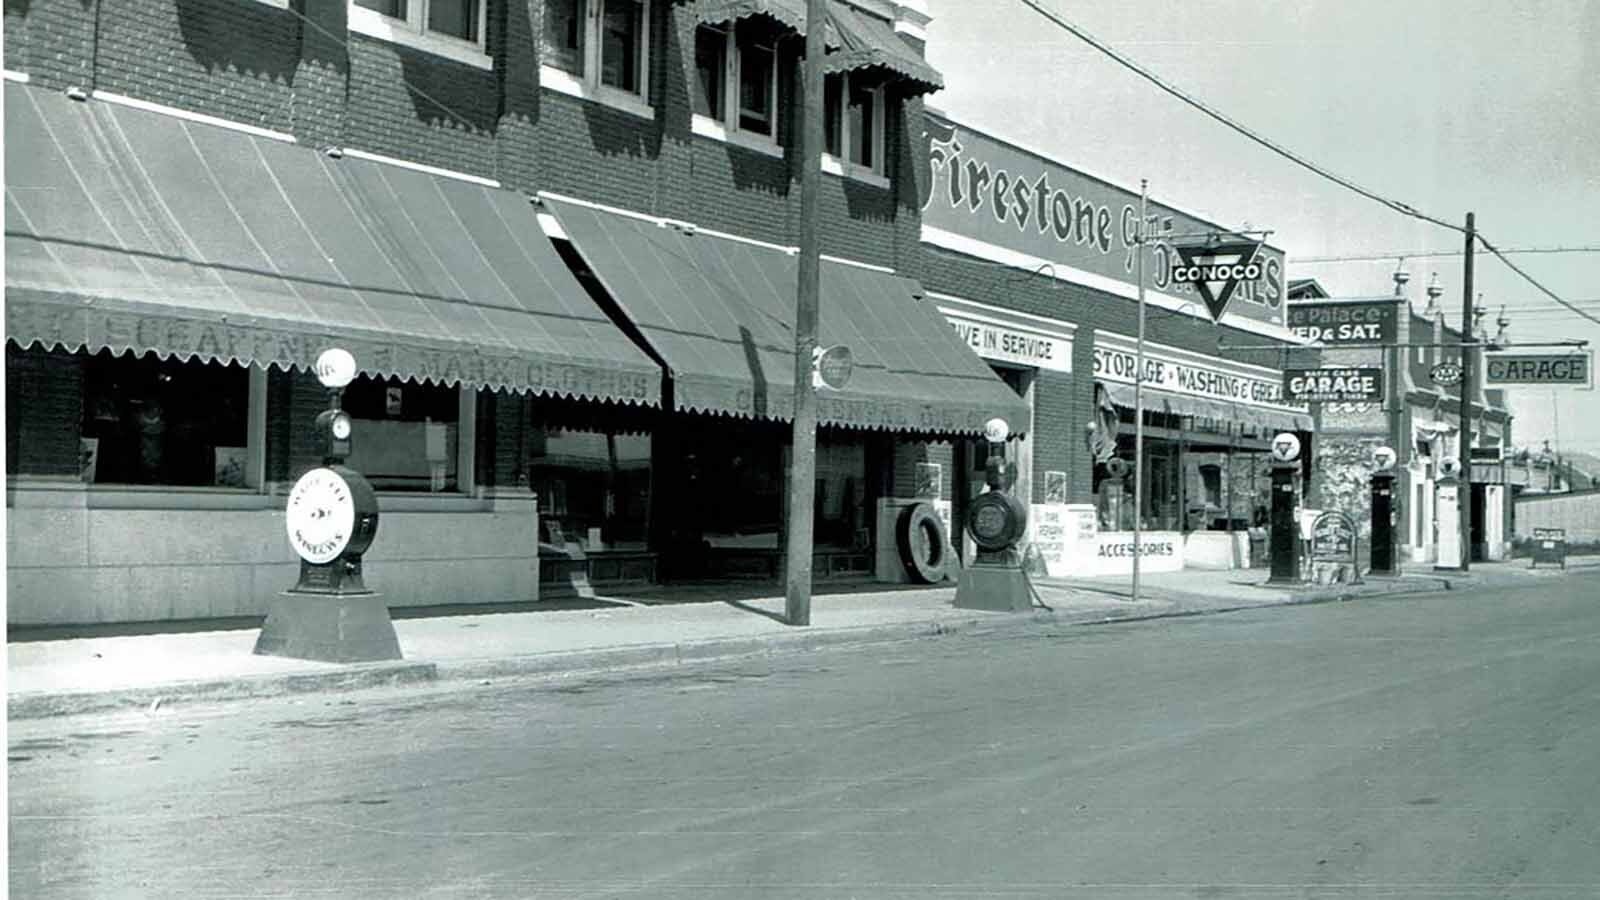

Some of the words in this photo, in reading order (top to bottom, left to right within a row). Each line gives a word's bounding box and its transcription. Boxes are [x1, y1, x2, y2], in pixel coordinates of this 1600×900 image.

[919, 116, 1113, 255] Firestone
[1174, 264, 1260, 282] CONOCO
[1338, 323, 1382, 340] SAT.
[983, 329, 997, 349] IN
[1002, 333, 1053, 360] SERVICE
[1487, 359, 1585, 381] GARAGE
[1175, 365, 1239, 399] WASHING
[1290, 376, 1375, 393] GARAGE
